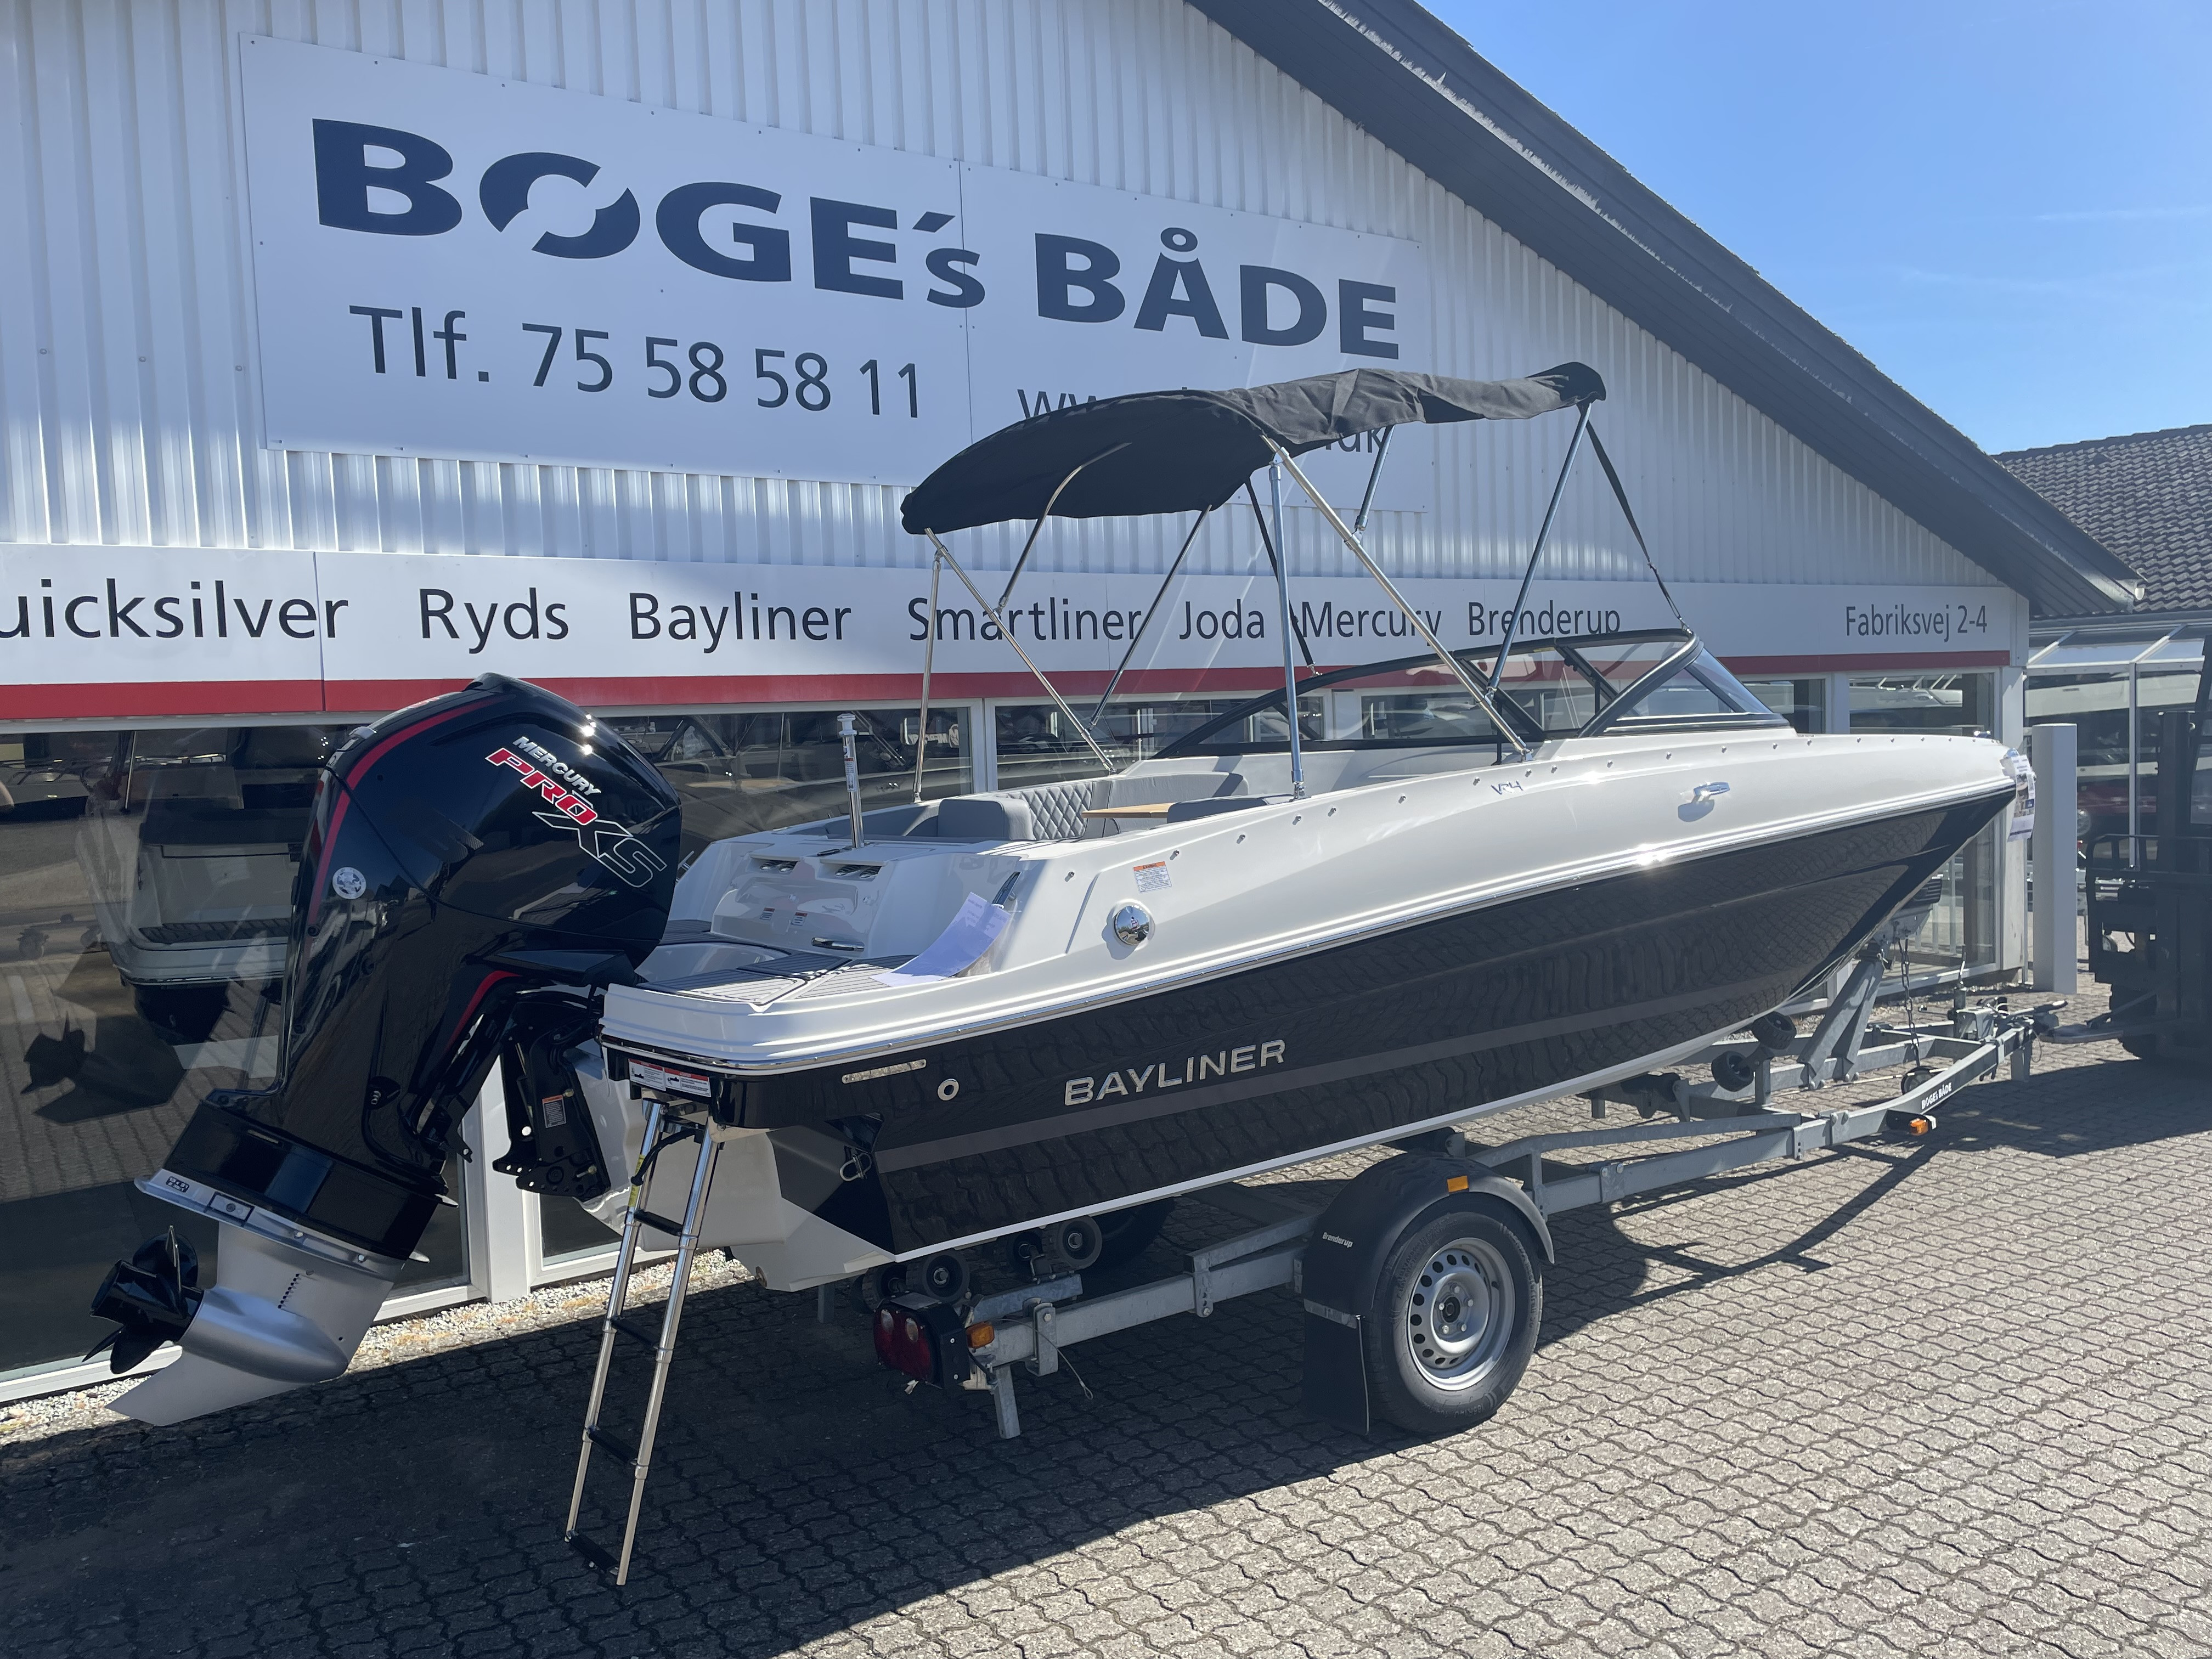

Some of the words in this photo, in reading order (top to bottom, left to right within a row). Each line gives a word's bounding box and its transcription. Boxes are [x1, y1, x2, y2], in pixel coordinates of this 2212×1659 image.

[1035, 226, 1399, 360] BÅDE
[349, 305, 489, 382] Tlf.
[522, 323, 613, 392] 75
[646, 336, 727, 403] 58
[755, 348, 831, 411] 58
[859, 359, 918, 419] 11
[419, 588, 569, 654] Ryds
[629, 591, 851, 654] Bayliner
[908, 597, 1142, 641] Smartliner
[1179, 599, 1265, 640] Joda
[1302, 601, 1442, 646] Mercury
[1468, 600, 1620, 636] Brenderup
[1846, 604, 1950, 642] Fabriksvej
[1957, 605, 1988, 634] 2-4
[484, 747, 599, 826] PRO
[512, 736, 601, 796] MERCURY
[1064, 1039, 1287, 1106] BAYLINER
[1322, 1232, 1354, 1249] Brenderup
